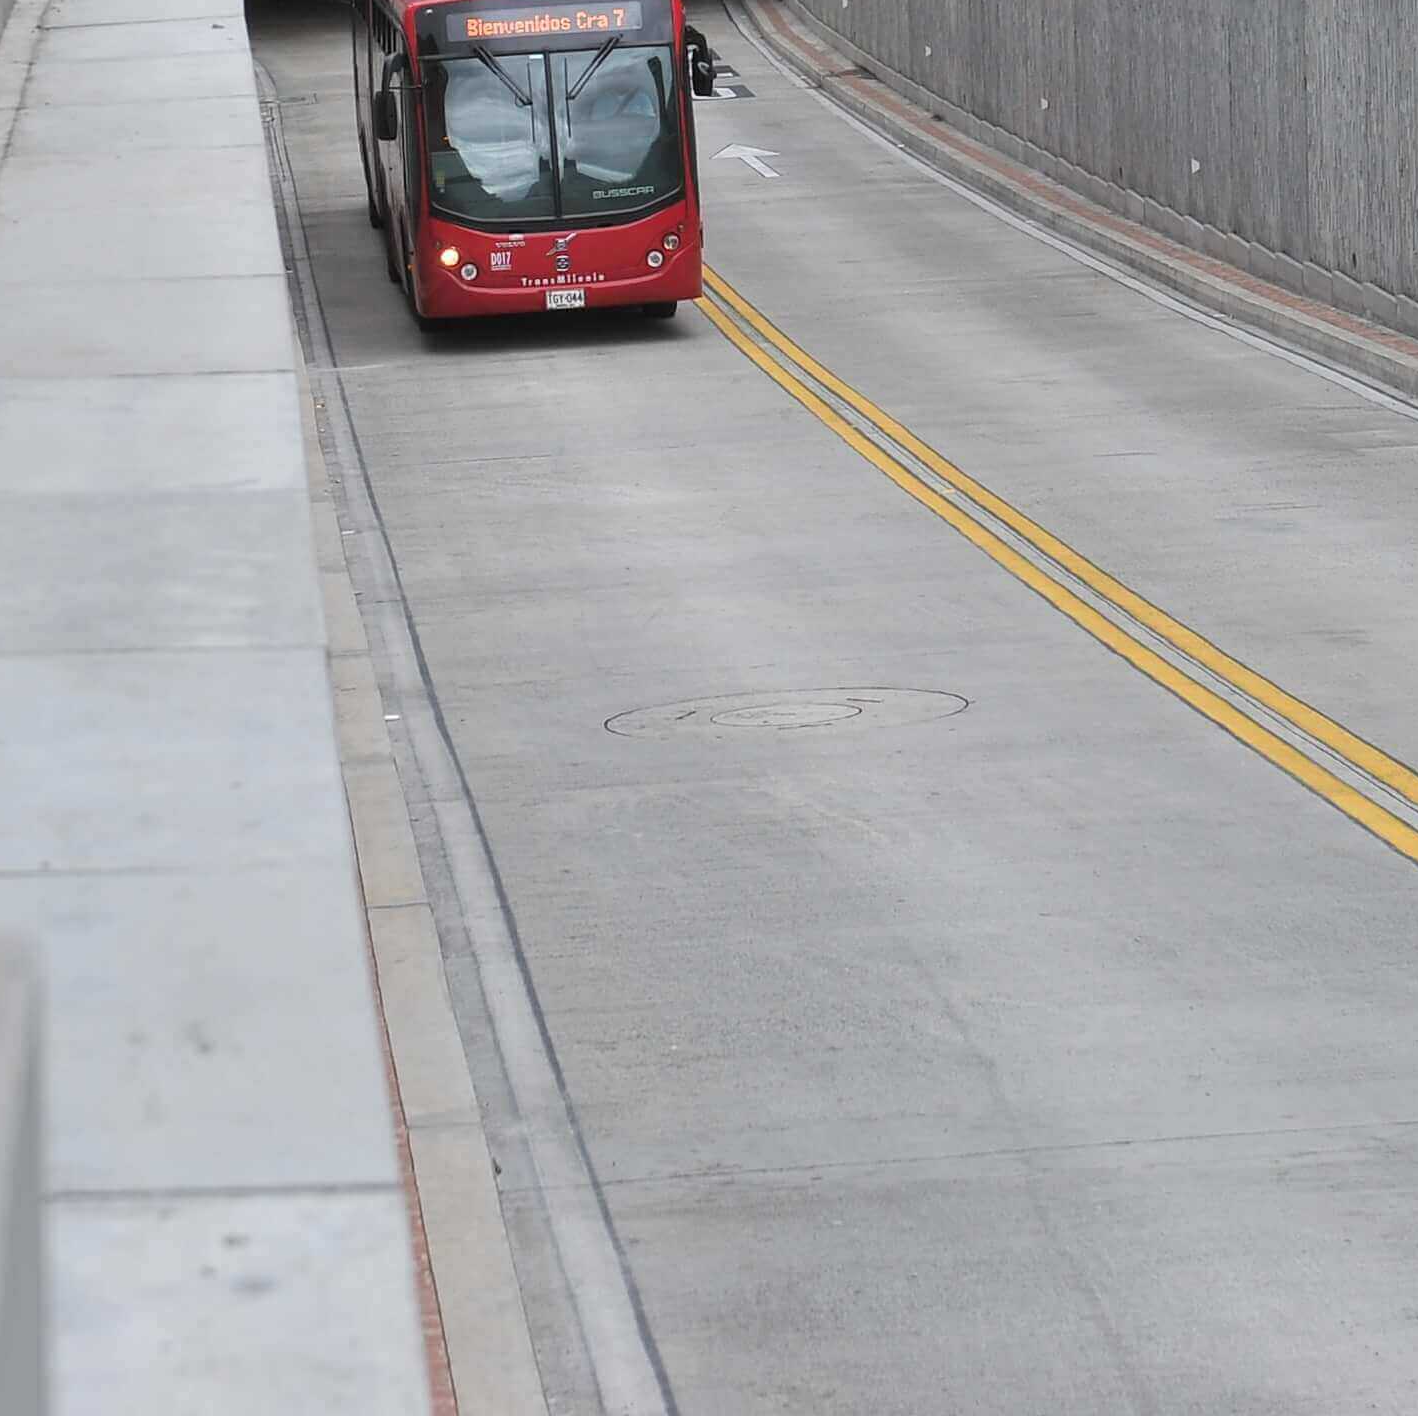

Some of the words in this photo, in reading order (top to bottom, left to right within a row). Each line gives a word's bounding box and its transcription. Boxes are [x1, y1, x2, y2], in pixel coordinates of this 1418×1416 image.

[467, 15, 571, 37] Bienvenidos
[576, 11, 608, 30] Cra
[613, 8, 624, 27] 7
